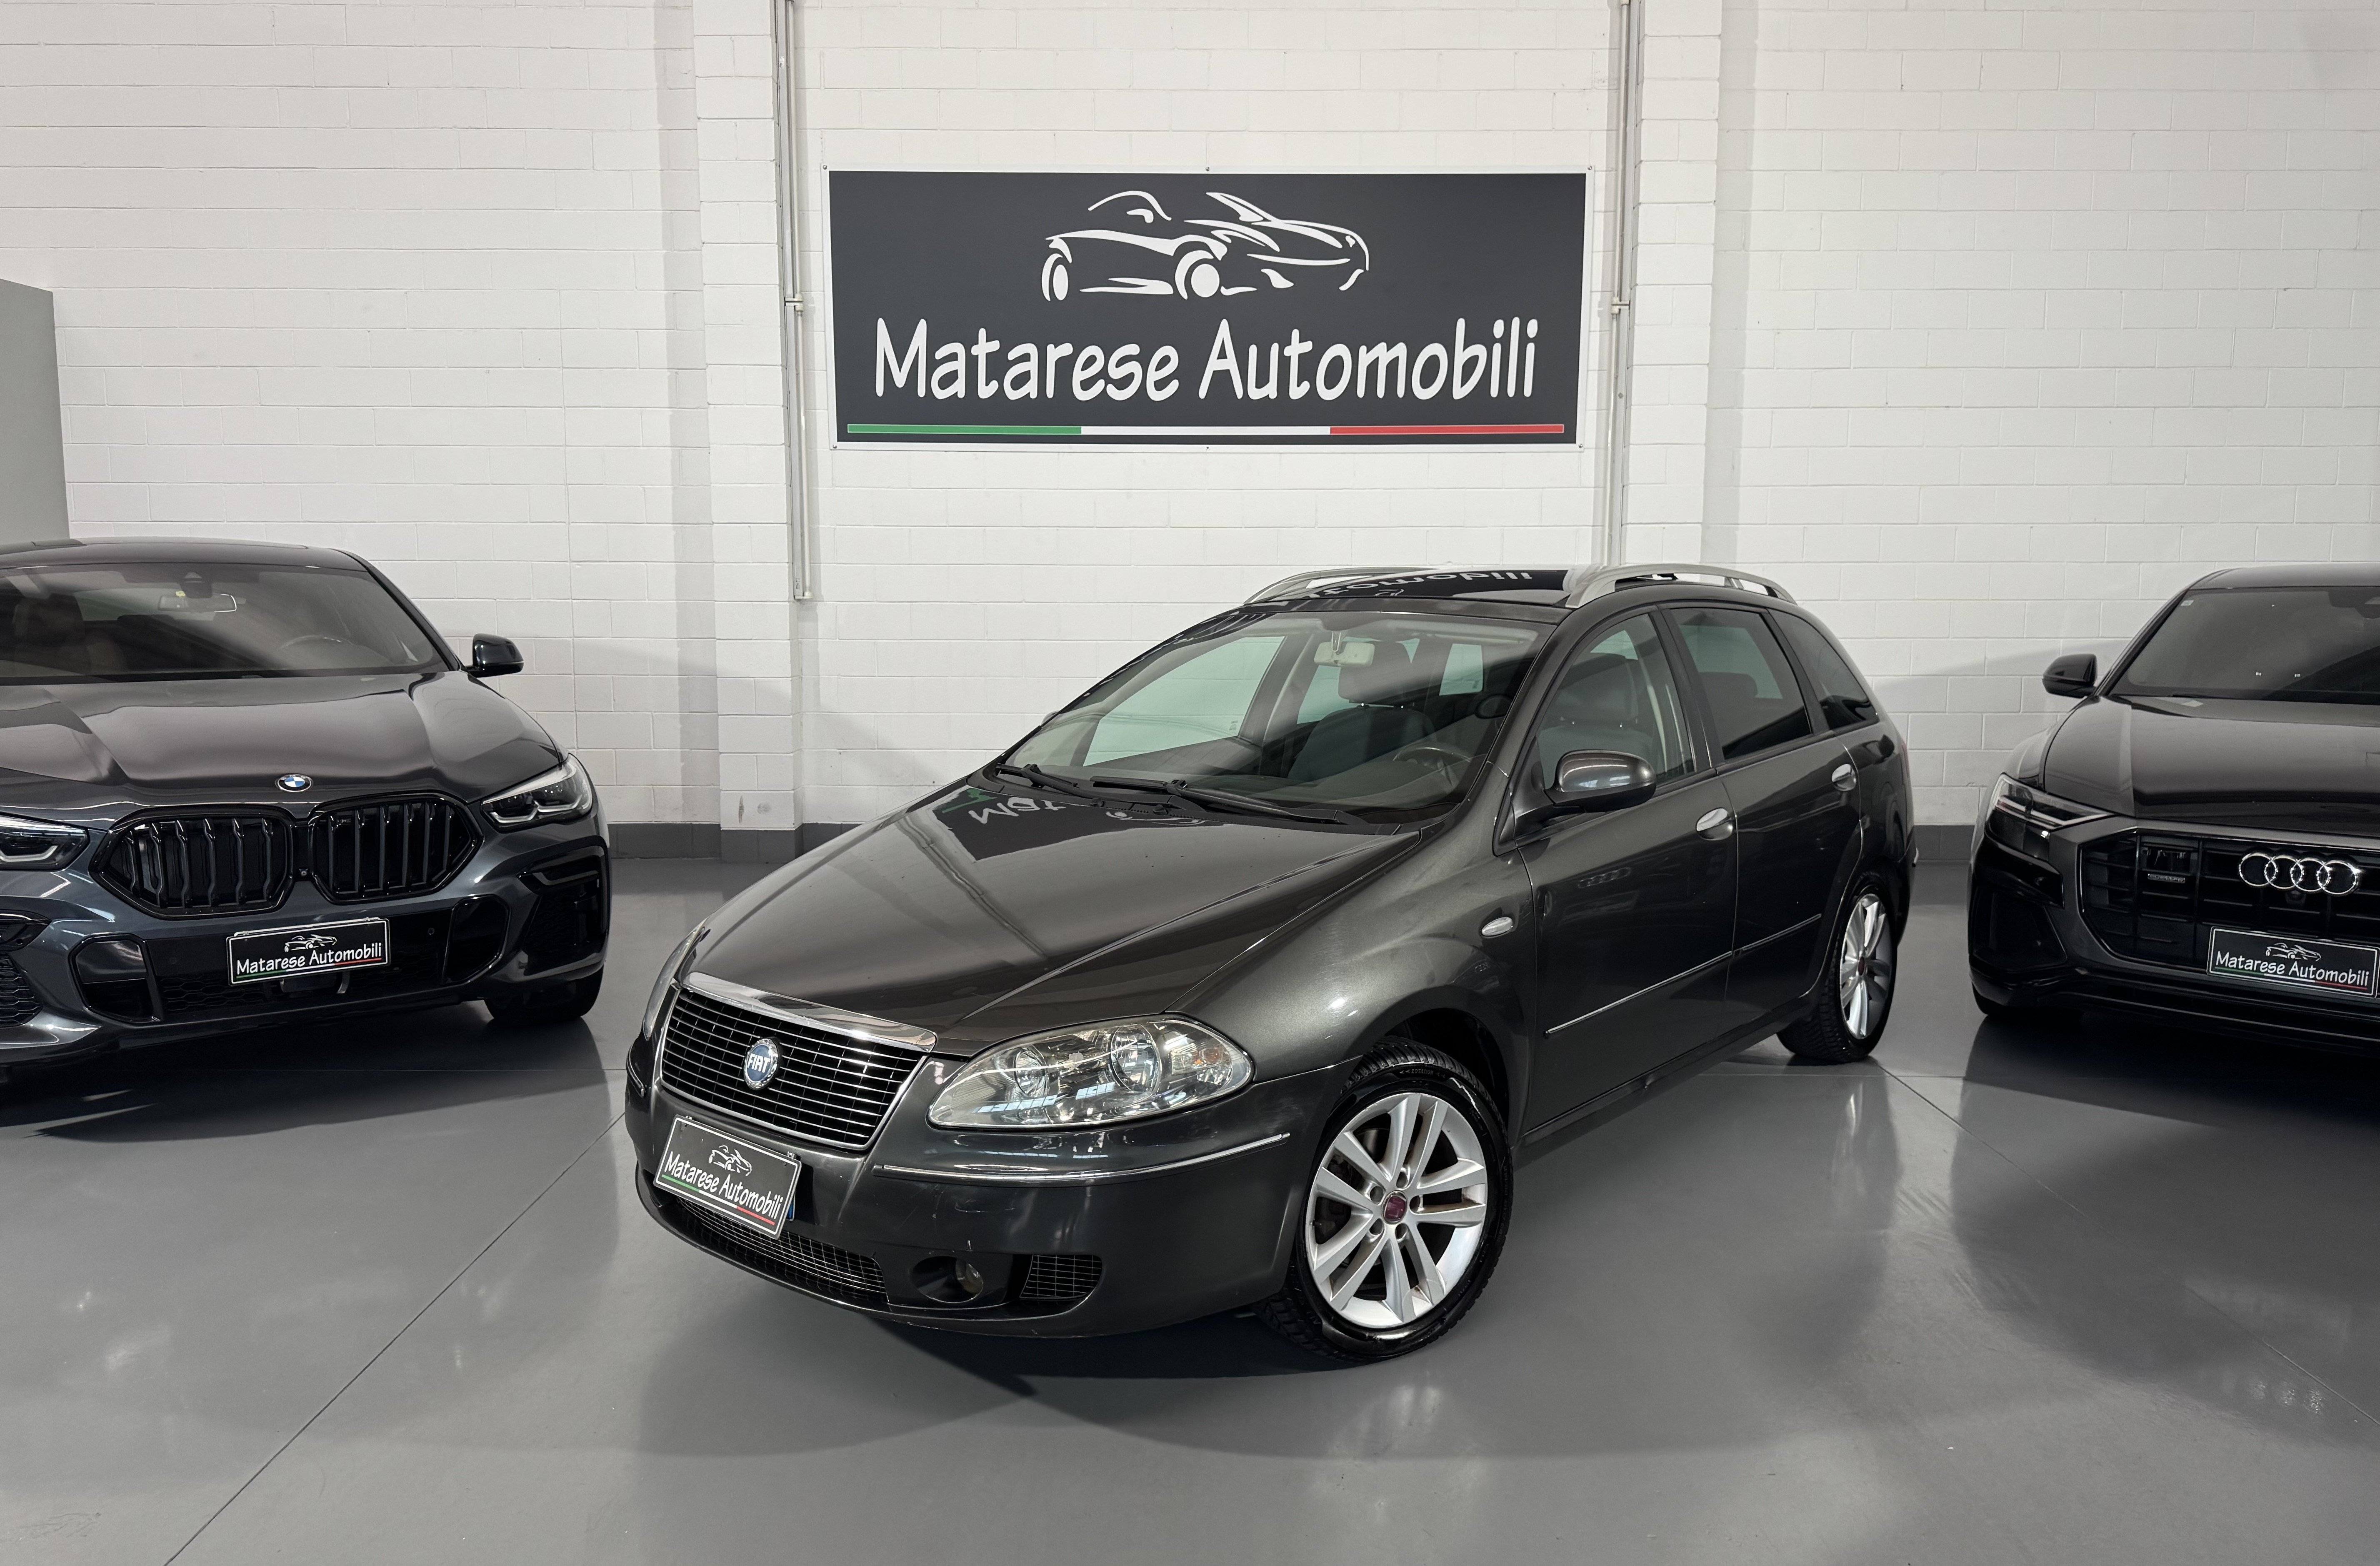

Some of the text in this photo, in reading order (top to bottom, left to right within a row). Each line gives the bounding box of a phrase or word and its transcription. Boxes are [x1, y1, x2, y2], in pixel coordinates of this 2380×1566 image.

[876, 317, 1538, 401] Matarese Automobili
[238, 943, 381, 975] Matarese Automobili
[2216, 951, 2369, 986] Matarese Automobili
[747, 1053, 771, 1073] FIAT
[664, 1151, 783, 1219] Matarese Automobili
